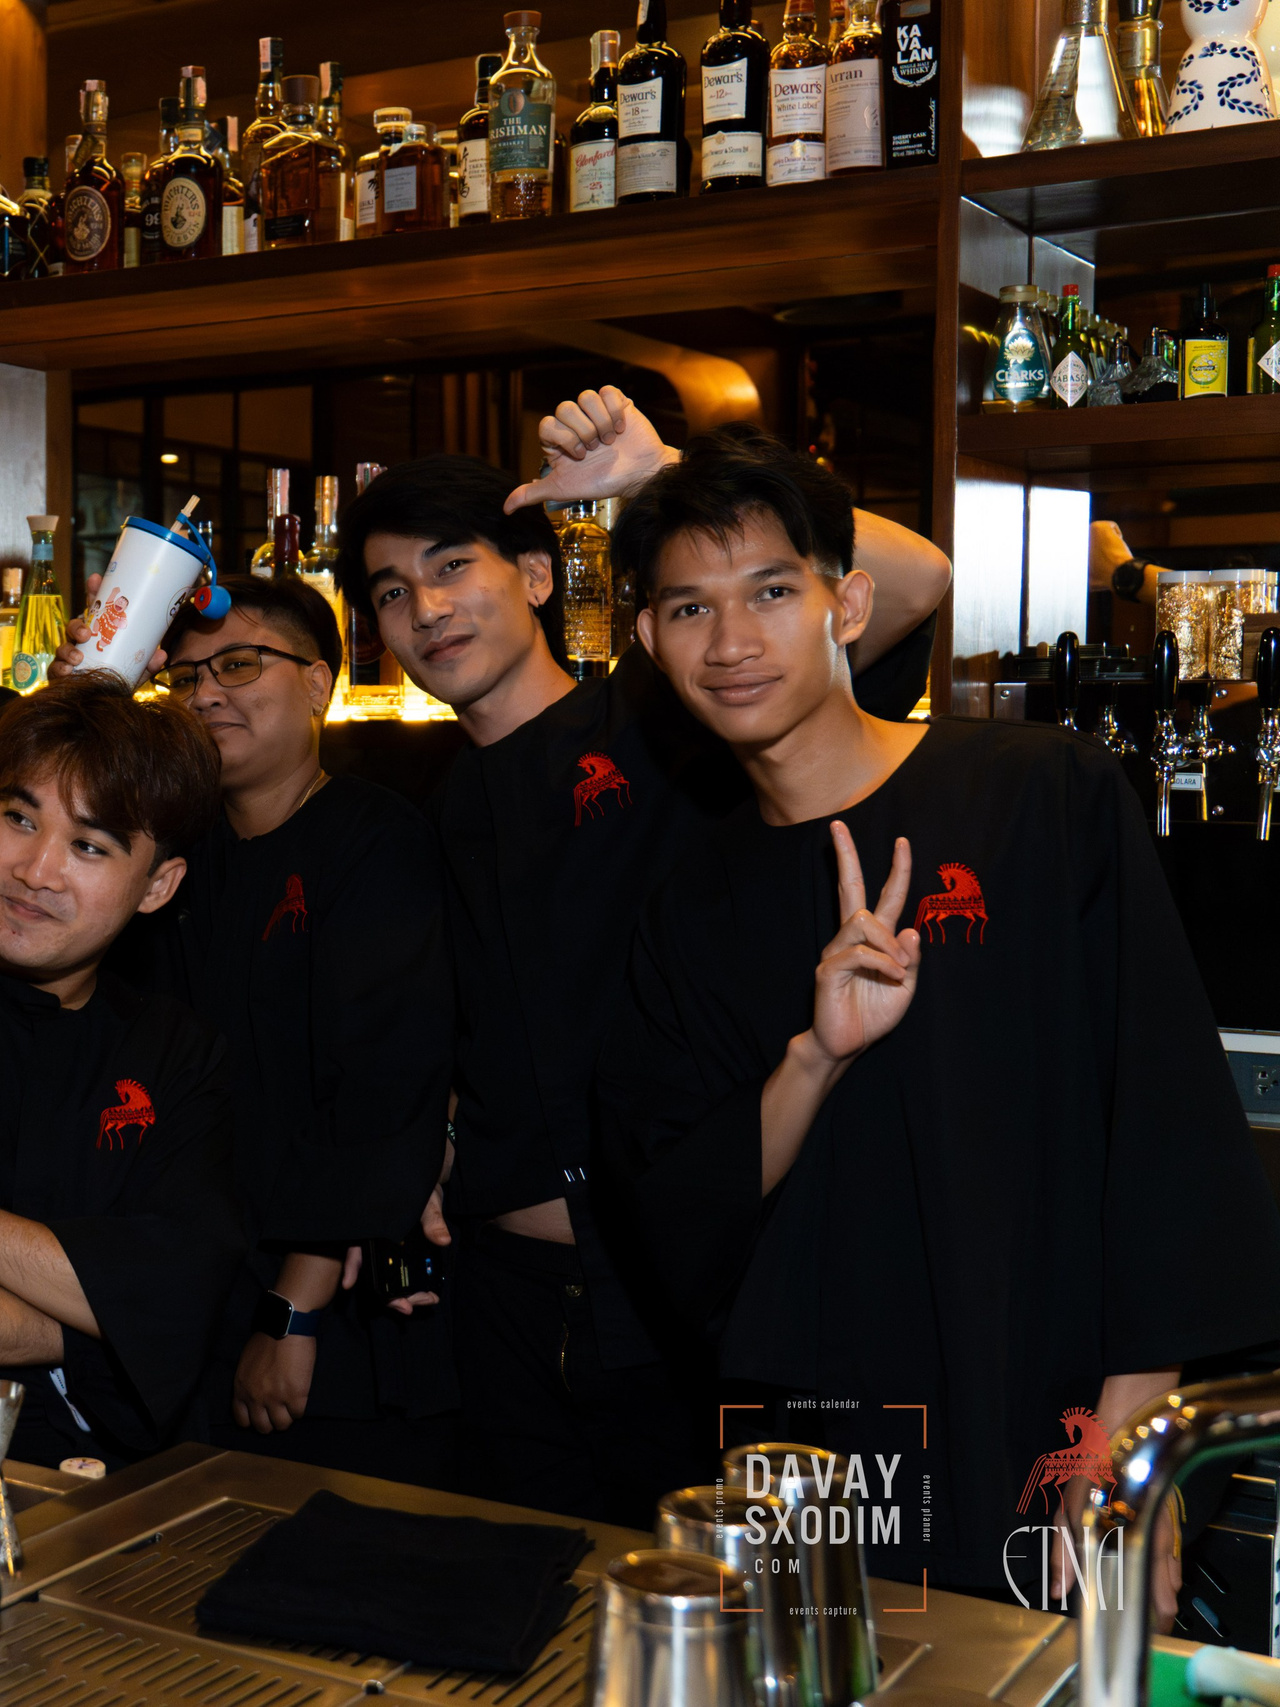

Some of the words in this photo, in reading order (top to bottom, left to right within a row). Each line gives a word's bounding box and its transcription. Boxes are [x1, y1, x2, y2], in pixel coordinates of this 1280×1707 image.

[897, 24, 922, 39] KA
[897, 37, 922, 52] VA
[897, 47, 933, 65] LAN
[900, 65, 930, 76] WHISKY
[704, 72, 744, 88] Dewar's
[716, 88, 725, 100] 12
[774, 80, 823, 98] Dewar's
[631, 106, 641, 117] 18
[777, 103, 797, 112] White
[798, 101, 819, 110] Label
[503, 116, 522, 126] THE
[490, 125, 548, 140] RISHMAN
[995, 369, 1044, 382] CLARKS
